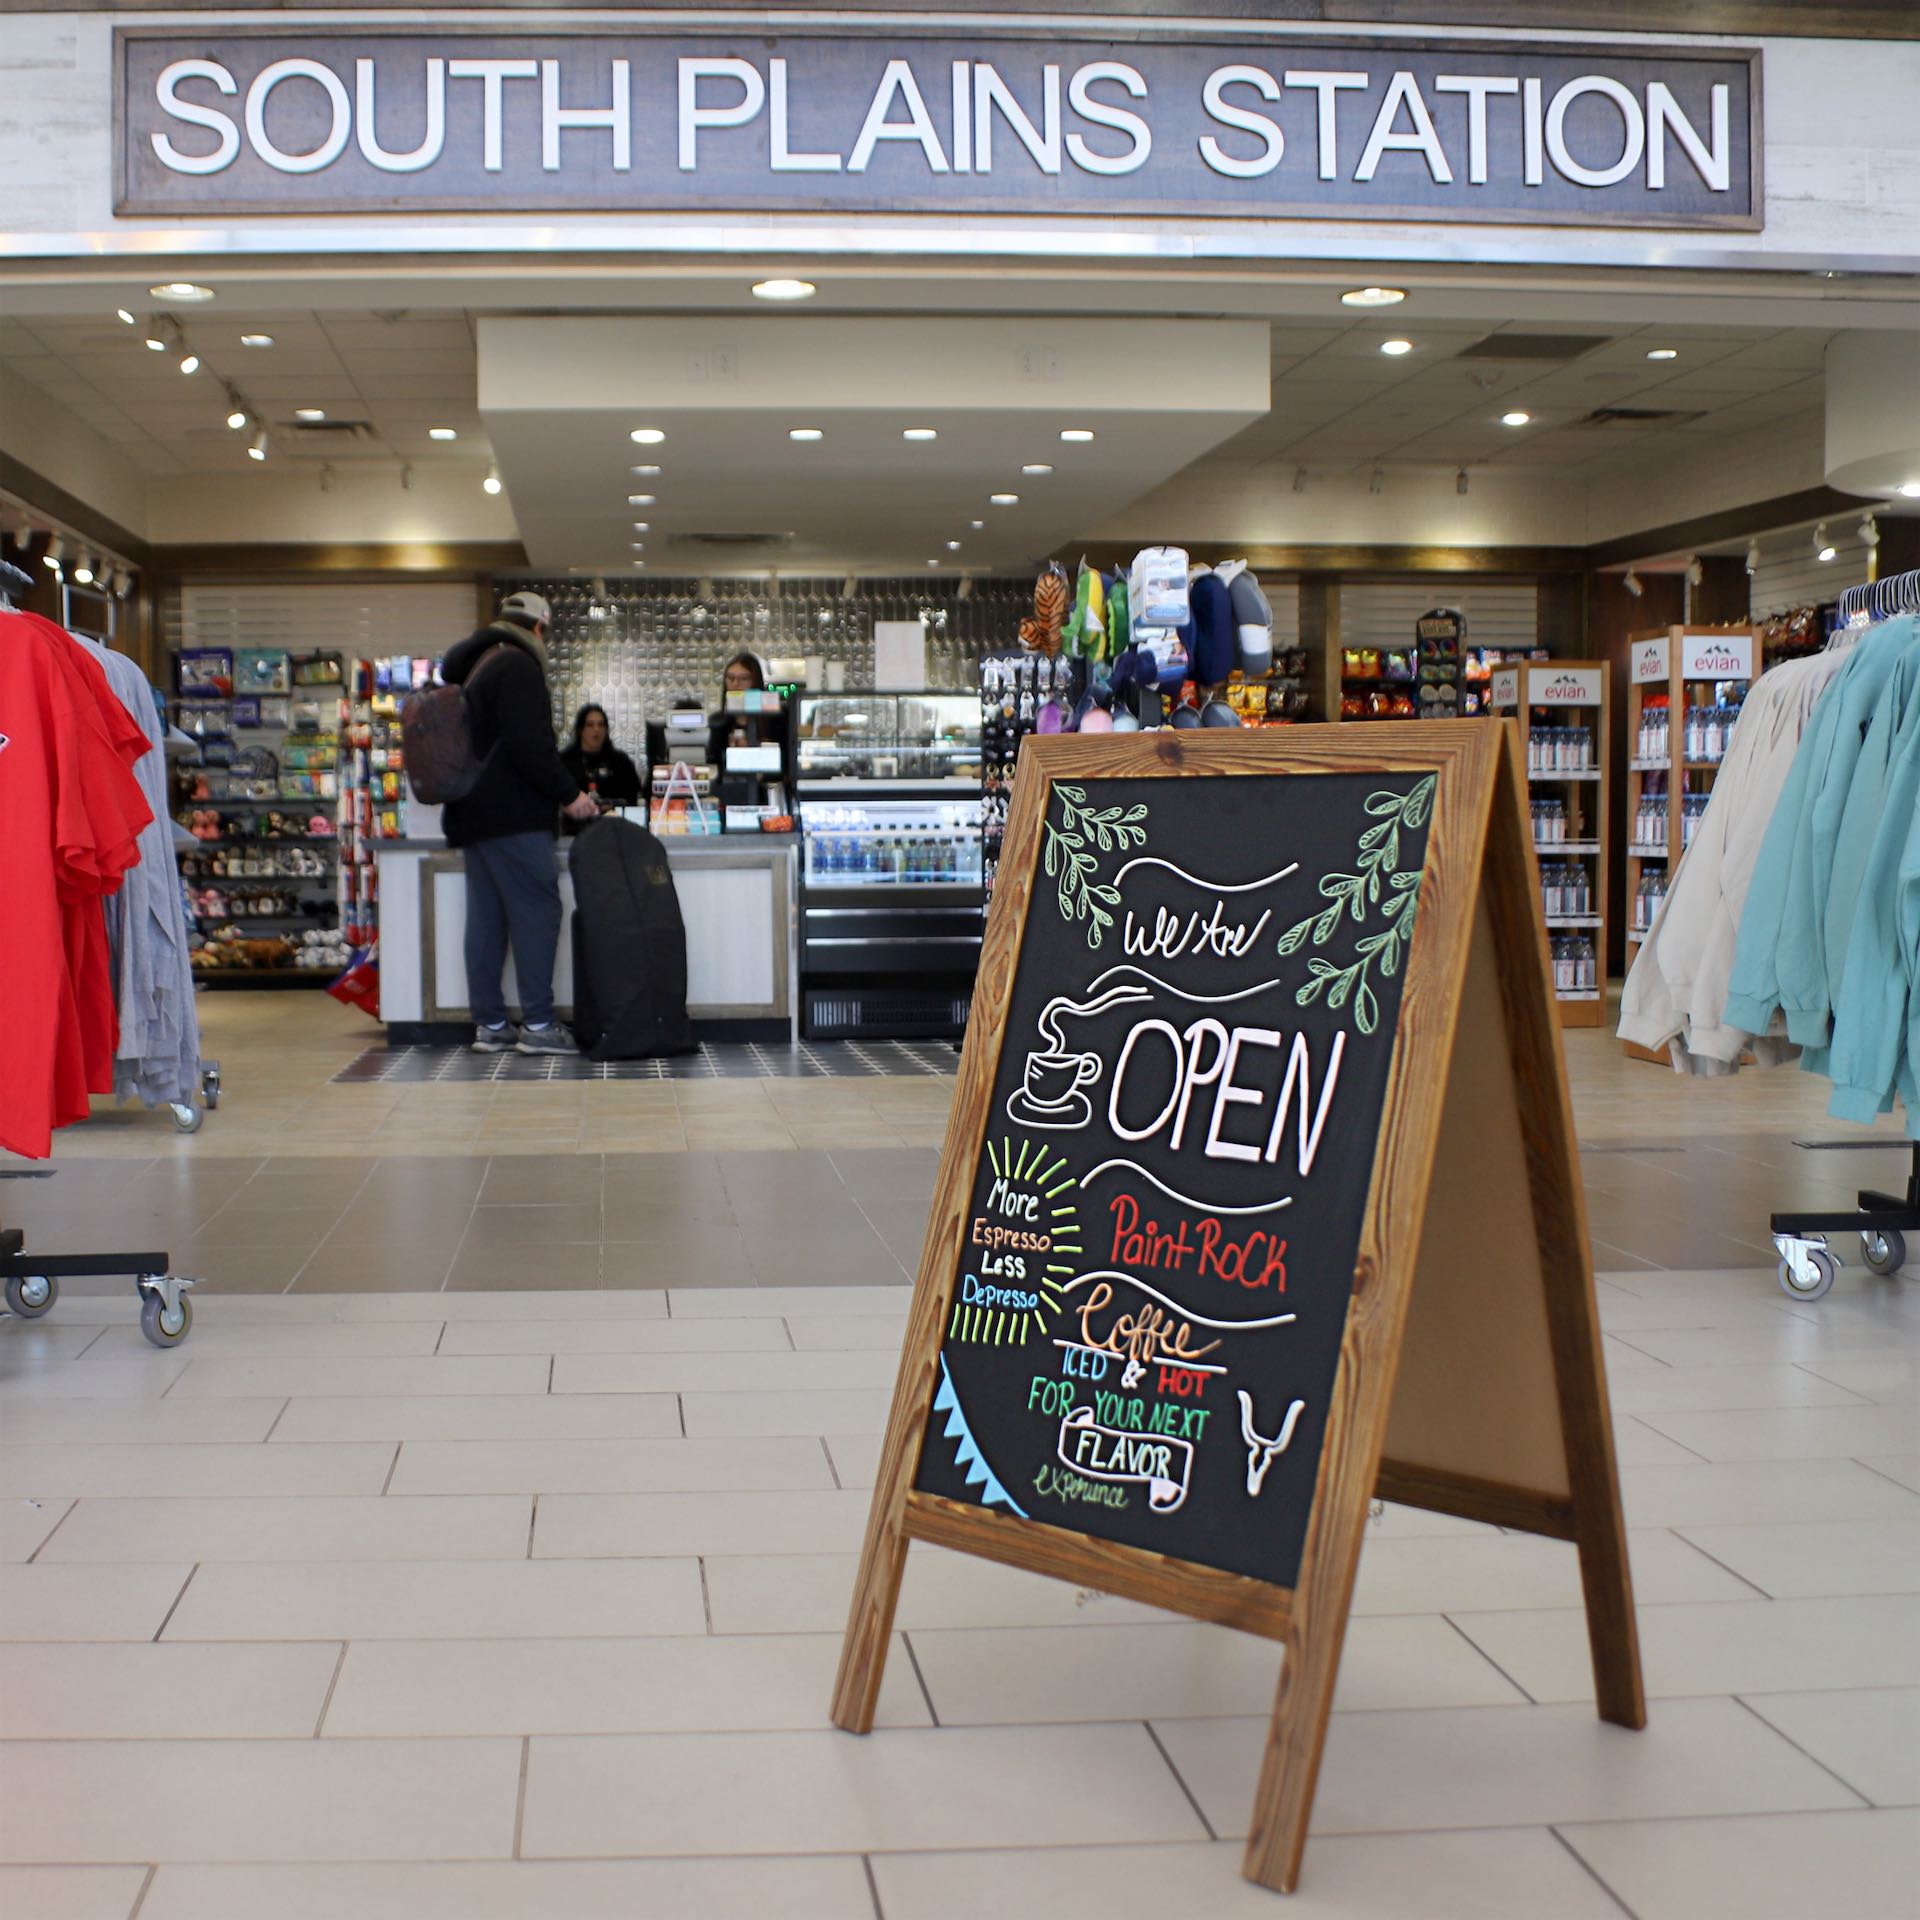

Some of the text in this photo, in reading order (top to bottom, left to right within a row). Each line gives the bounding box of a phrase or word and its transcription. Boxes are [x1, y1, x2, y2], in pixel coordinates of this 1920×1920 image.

[151, 58, 1730, 191] SOUTH PLAINS STATION
[1639, 658, 1662, 676] evian
[1694, 654, 1741, 672] evian
[1545, 684, 1587, 699] evian
[1108, 1017, 1346, 1178] OPEN
[986, 1177, 1040, 1223] More
[972, 1217, 1052, 1253] Espresso
[1109, 1194, 1194, 1269] Paint
[962, 1273, 1039, 1308] Depresso
[1076, 1282, 1224, 1363] Coffee
[1062, 1346, 1212, 1398] ICED & HOT
[1028, 1376, 1211, 1441] FOR YOUR NEXT
[1075, 1430, 1172, 1480] FLAVOR
